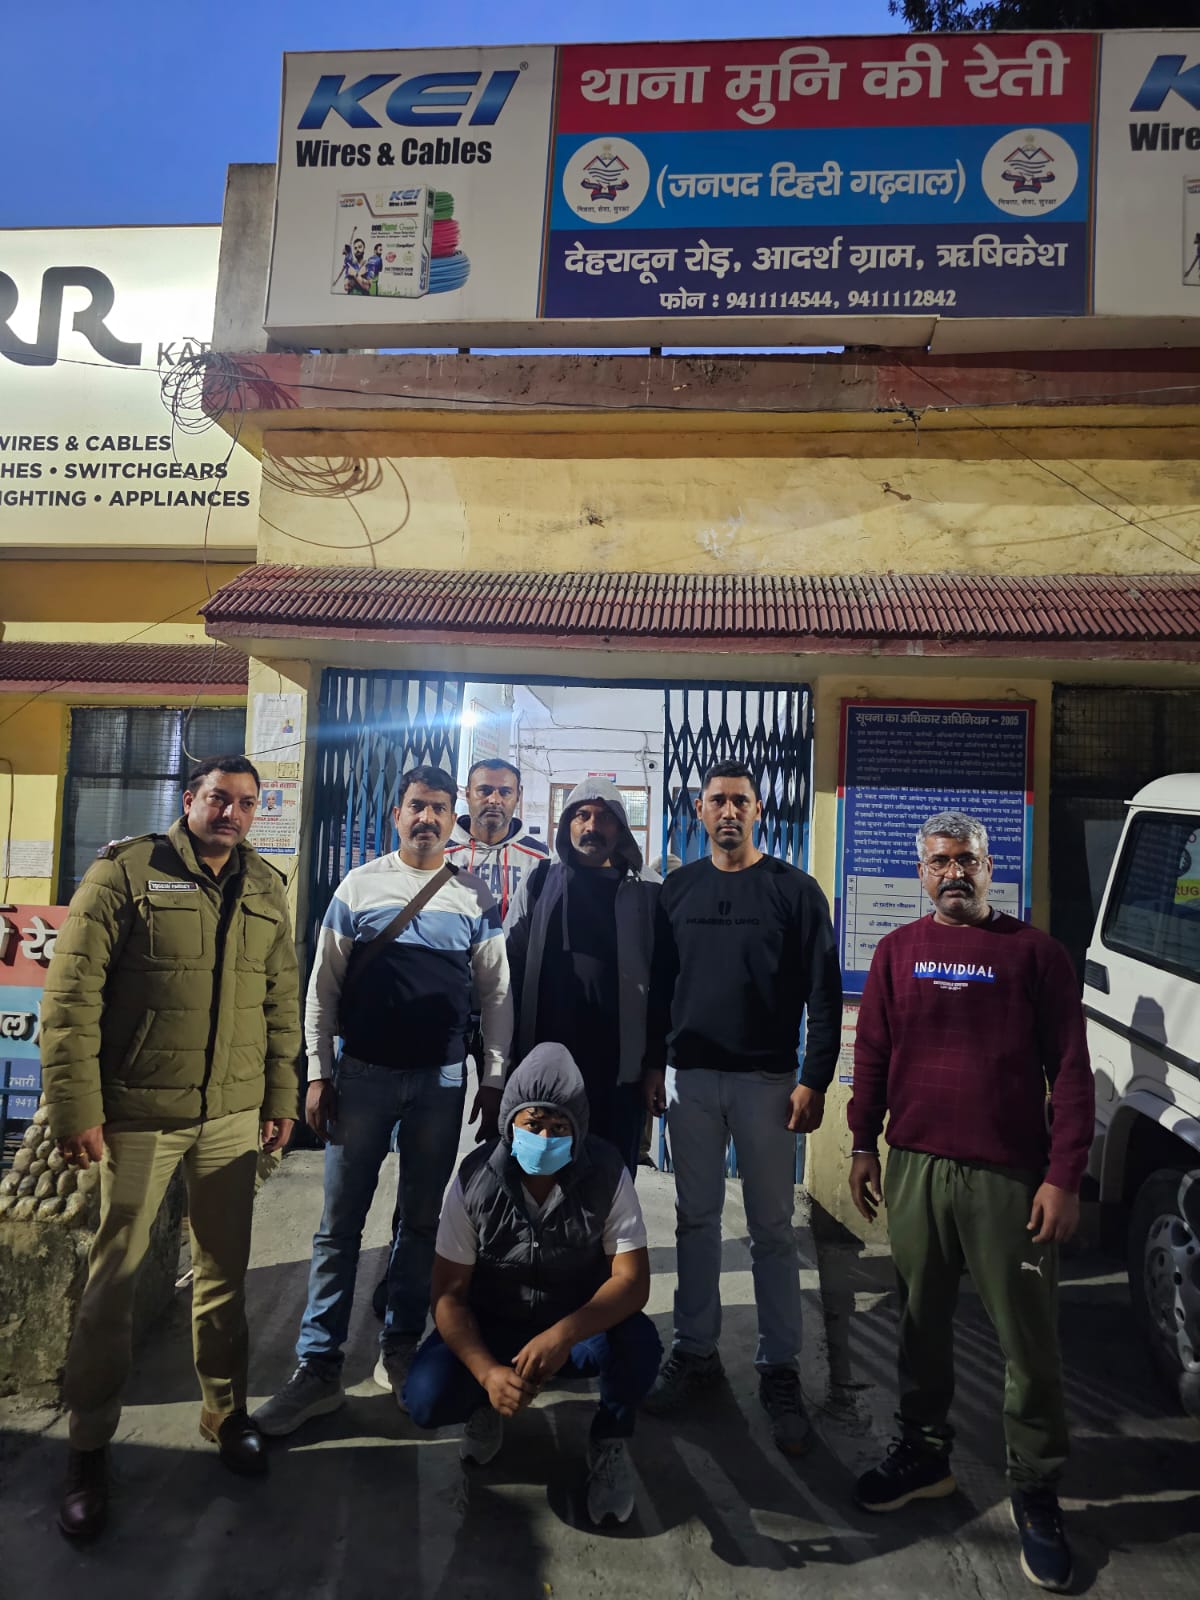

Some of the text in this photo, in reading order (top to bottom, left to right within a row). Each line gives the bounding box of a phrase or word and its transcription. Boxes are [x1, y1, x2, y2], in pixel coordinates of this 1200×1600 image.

[580, 39, 1070, 125] थाना मुनि की रेती
[297, 69, 520, 130] KEI
[296, 137, 492, 168] Wires & Cables
[656, 158, 966, 208] (जनपद टिहरी गढ़वाल)
[564, 233, 1069, 285] देहरादून रोड़, आदर्श ग्राम, ऋषिकेश
[659, 287, 706, 310] फोन
[726, 291, 840, 310] 9411114544,
[848, 289, 957, 308] 9411112842
[65, 435, 79, 451] &
[86, 435, 172, 451] CABLES
[64, 463, 228, 479] SWITCHGEARS
[109, 490, 250, 507] APPLIANCES
[855, 712, 884, 727] सूचना
[885, 713, 899, 723] का
[900, 710, 940, 724] अधिकार
[941, 712, 990, 726] अधिनियम
[914, 961, 994, 979] INDIVIDUAL
